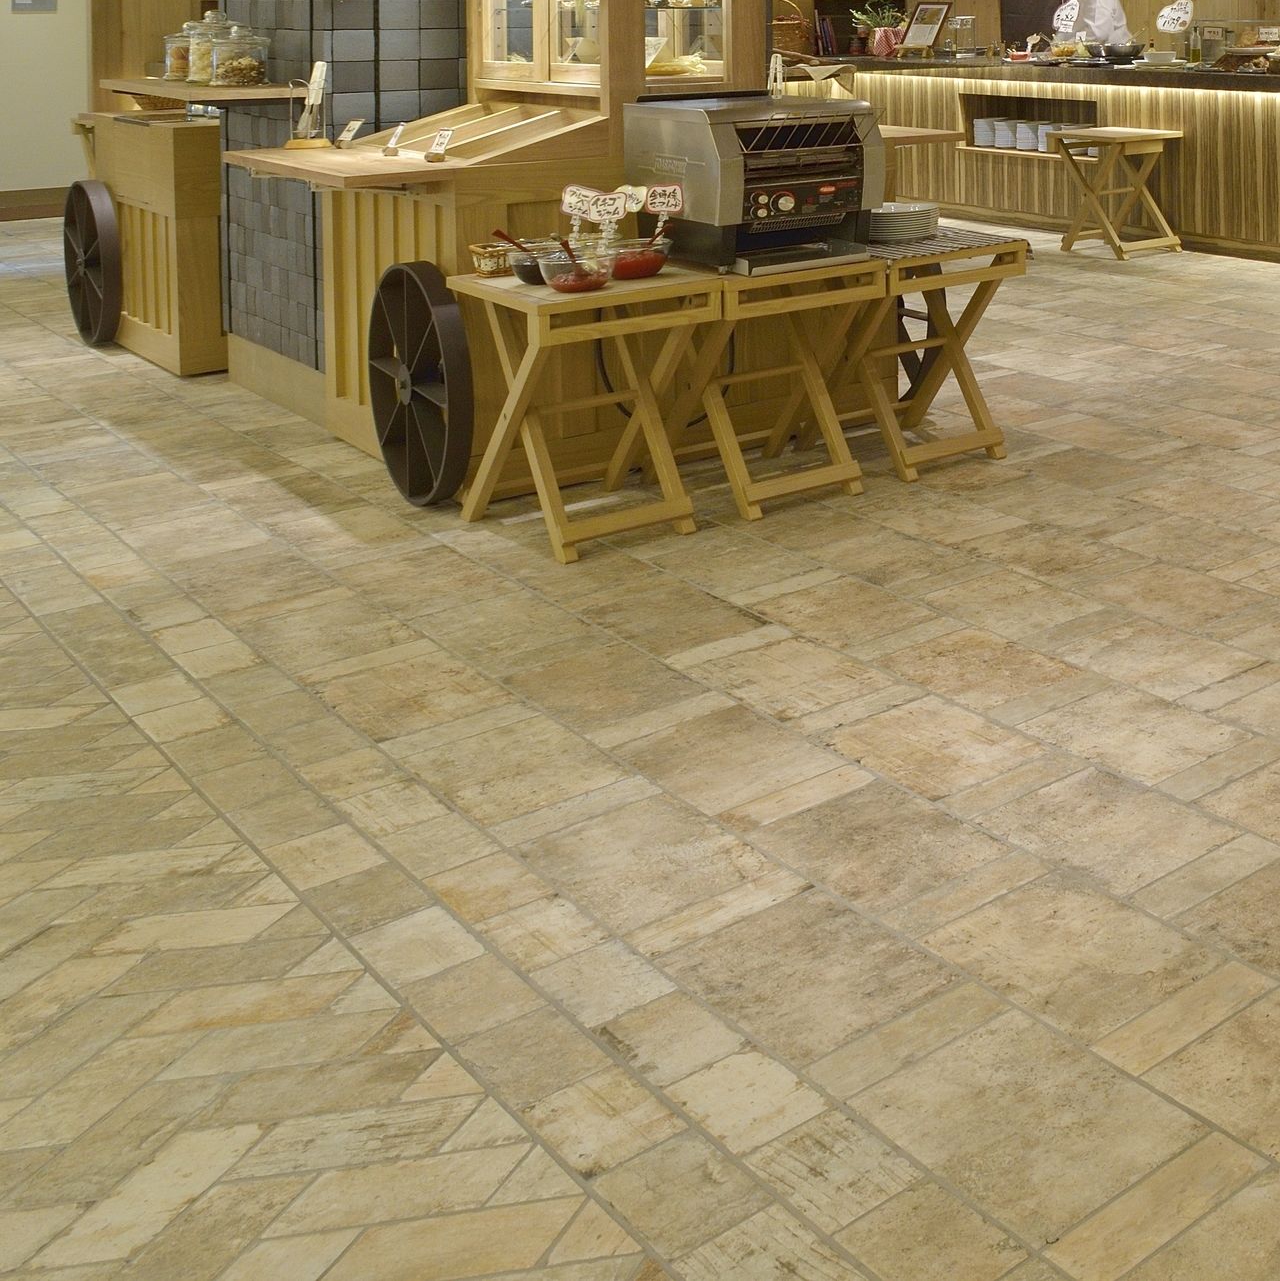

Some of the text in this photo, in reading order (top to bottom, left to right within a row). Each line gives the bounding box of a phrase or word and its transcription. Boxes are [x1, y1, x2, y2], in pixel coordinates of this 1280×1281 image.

[591, 196, 621, 209] イチゴ
[596, 206, 620, 218] ジャム
